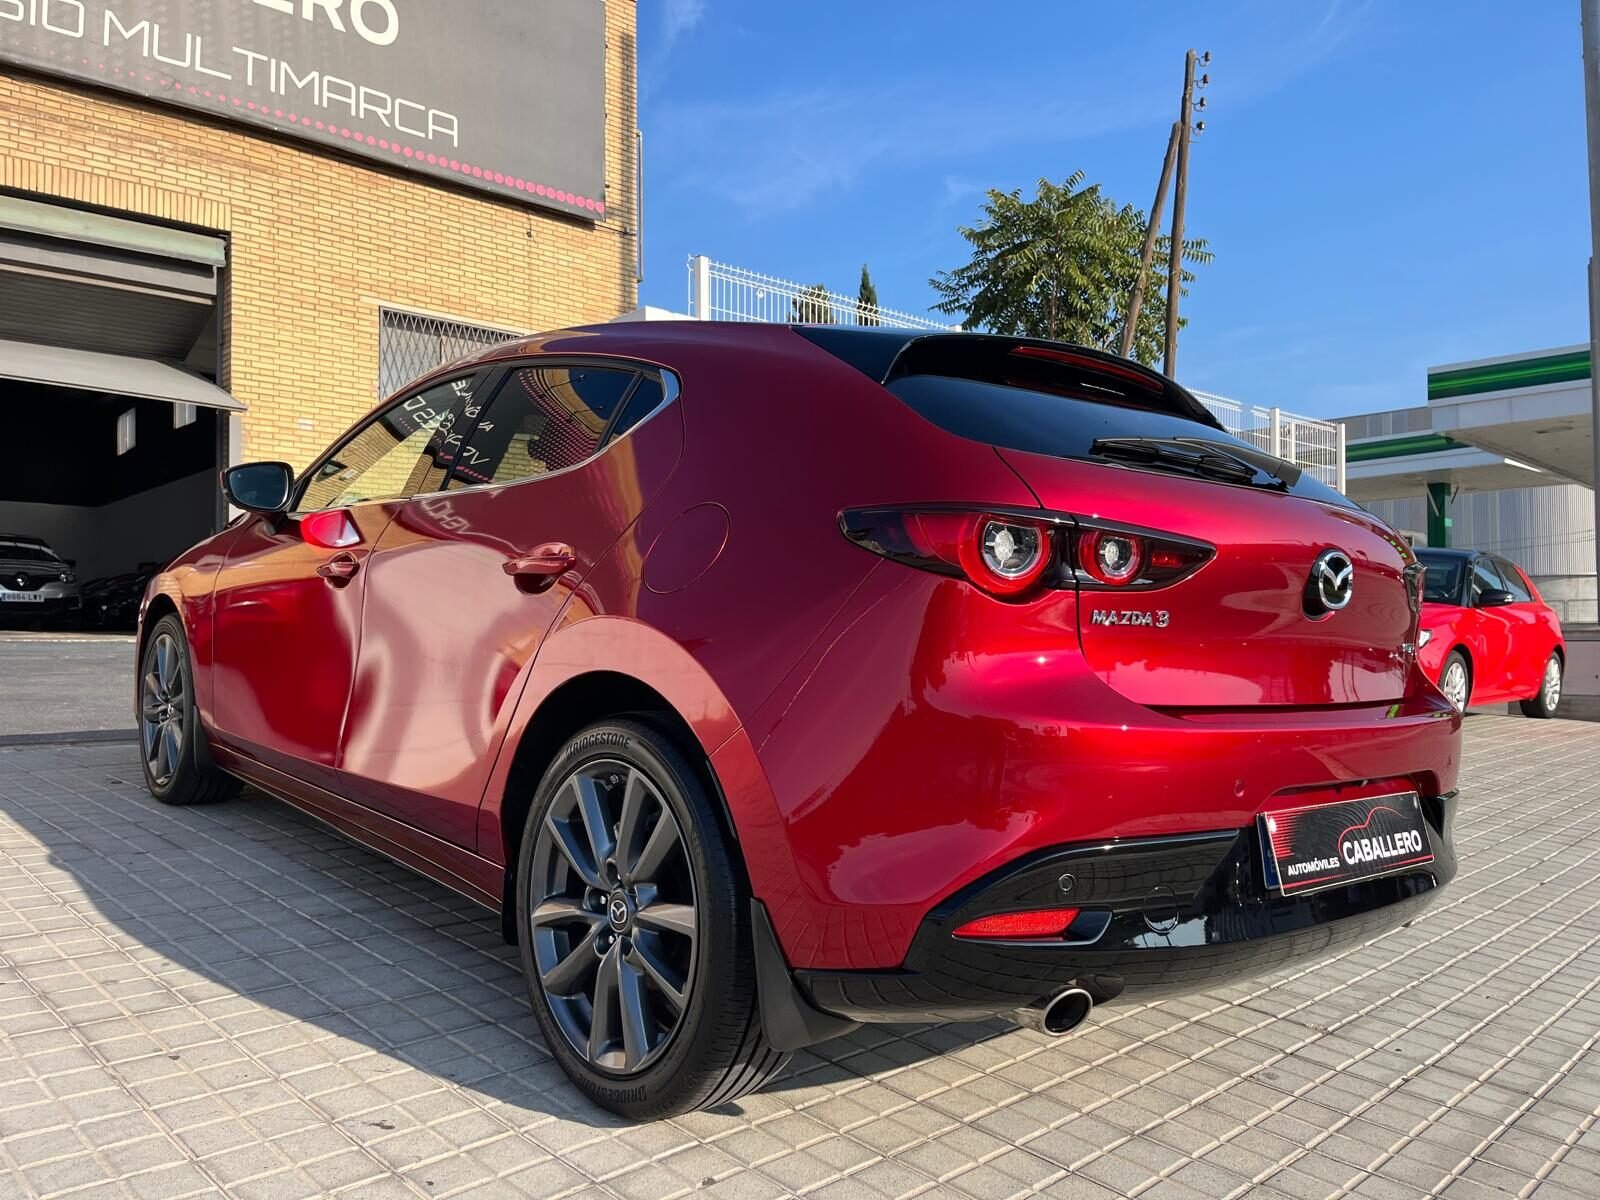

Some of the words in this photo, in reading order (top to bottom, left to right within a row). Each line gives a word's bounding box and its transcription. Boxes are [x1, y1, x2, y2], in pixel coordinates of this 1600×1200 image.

[103, 9, 458, 148] MULTIMARCA
[1287, 857, 1340, 877] AUTOMÓVILES
[1342, 829, 1423, 866] CABALLERO
